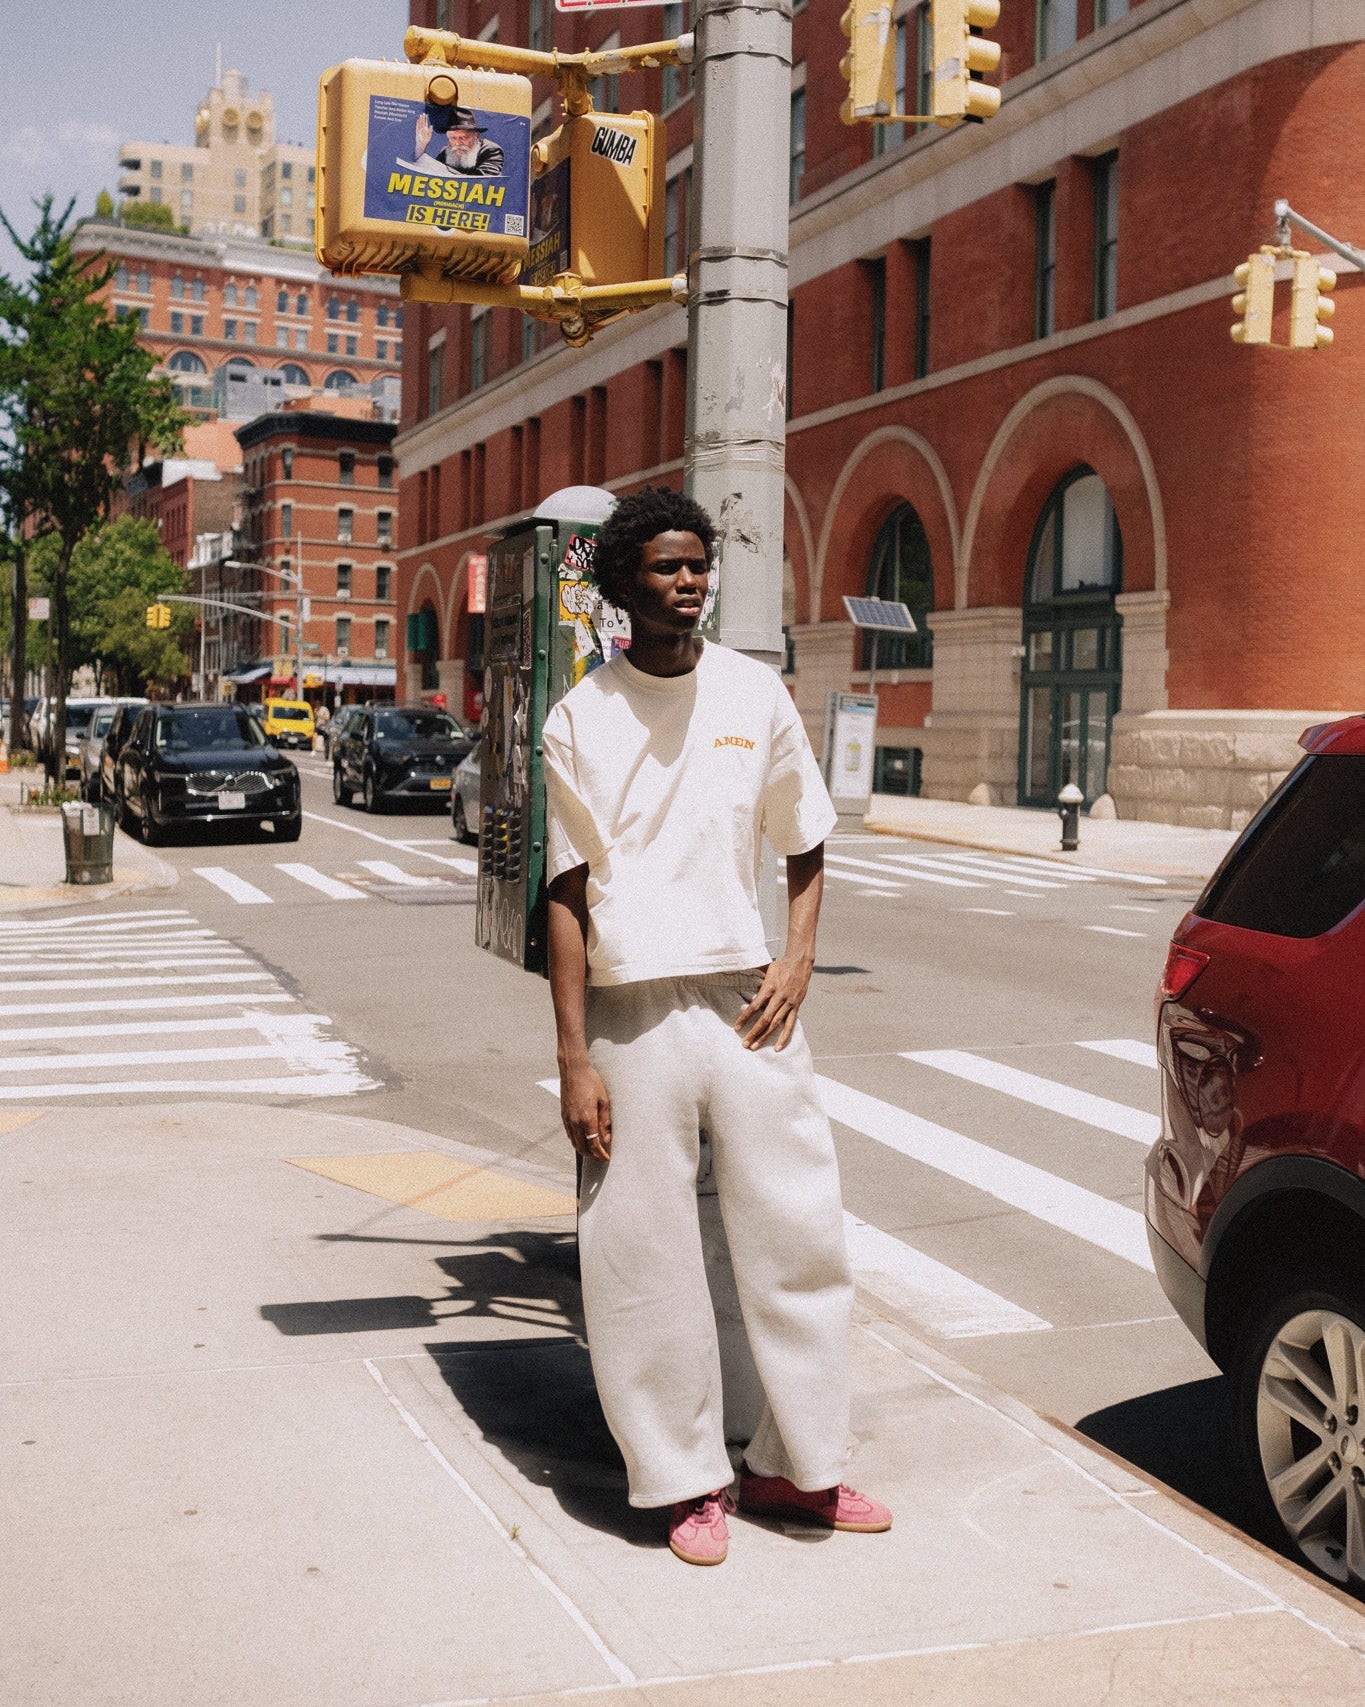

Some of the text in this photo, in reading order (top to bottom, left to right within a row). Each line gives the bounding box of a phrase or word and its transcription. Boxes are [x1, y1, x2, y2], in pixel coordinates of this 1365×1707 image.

[592, 126, 637, 165] GUMBA
[387, 172, 506, 207] MESSIAH
[409, 206, 489, 229] IS HERE!
